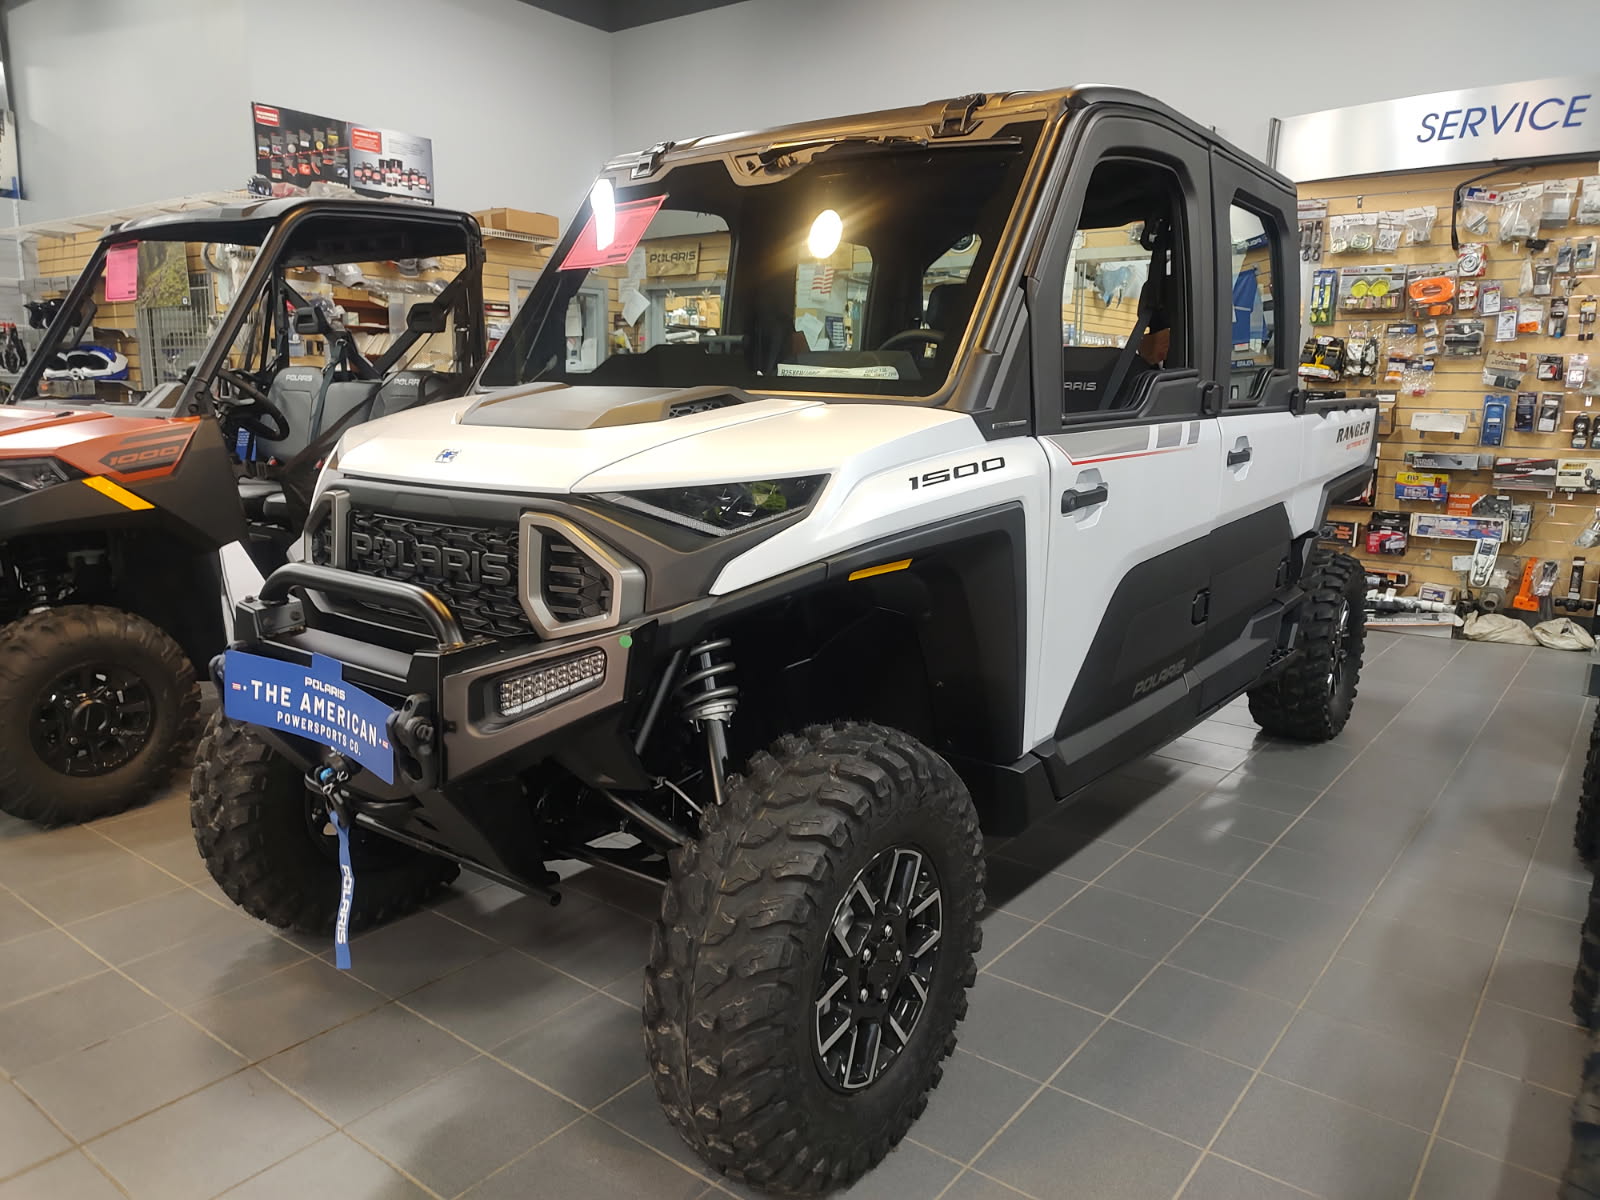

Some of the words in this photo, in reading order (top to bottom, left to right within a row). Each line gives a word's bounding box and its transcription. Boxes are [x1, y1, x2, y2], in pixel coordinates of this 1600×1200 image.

[1416, 94, 1592, 143] SERVICE
[649, 250, 697, 263] POLARIS
[285, 374, 313, 382] POLARIS
[393, 378, 420, 386] POLAR
[1063, 381, 1097, 391] ARIS
[1336, 420, 1371, 444] RANGER
[110, 445, 180, 466] 1000
[908, 456, 1006, 491] 1500
[351, 531, 511, 586] POLARIS
[304, 676, 346, 701] POLARIS
[1132, 657, 1187, 699] POLARIS
[250, 679, 292, 708] THE
[299, 692, 378, 748] AMERICAN
[276, 710, 348, 747] POWERSPORTS
[349, 740, 362, 757] CO.
[337, 864, 353, 945] POLARIS
